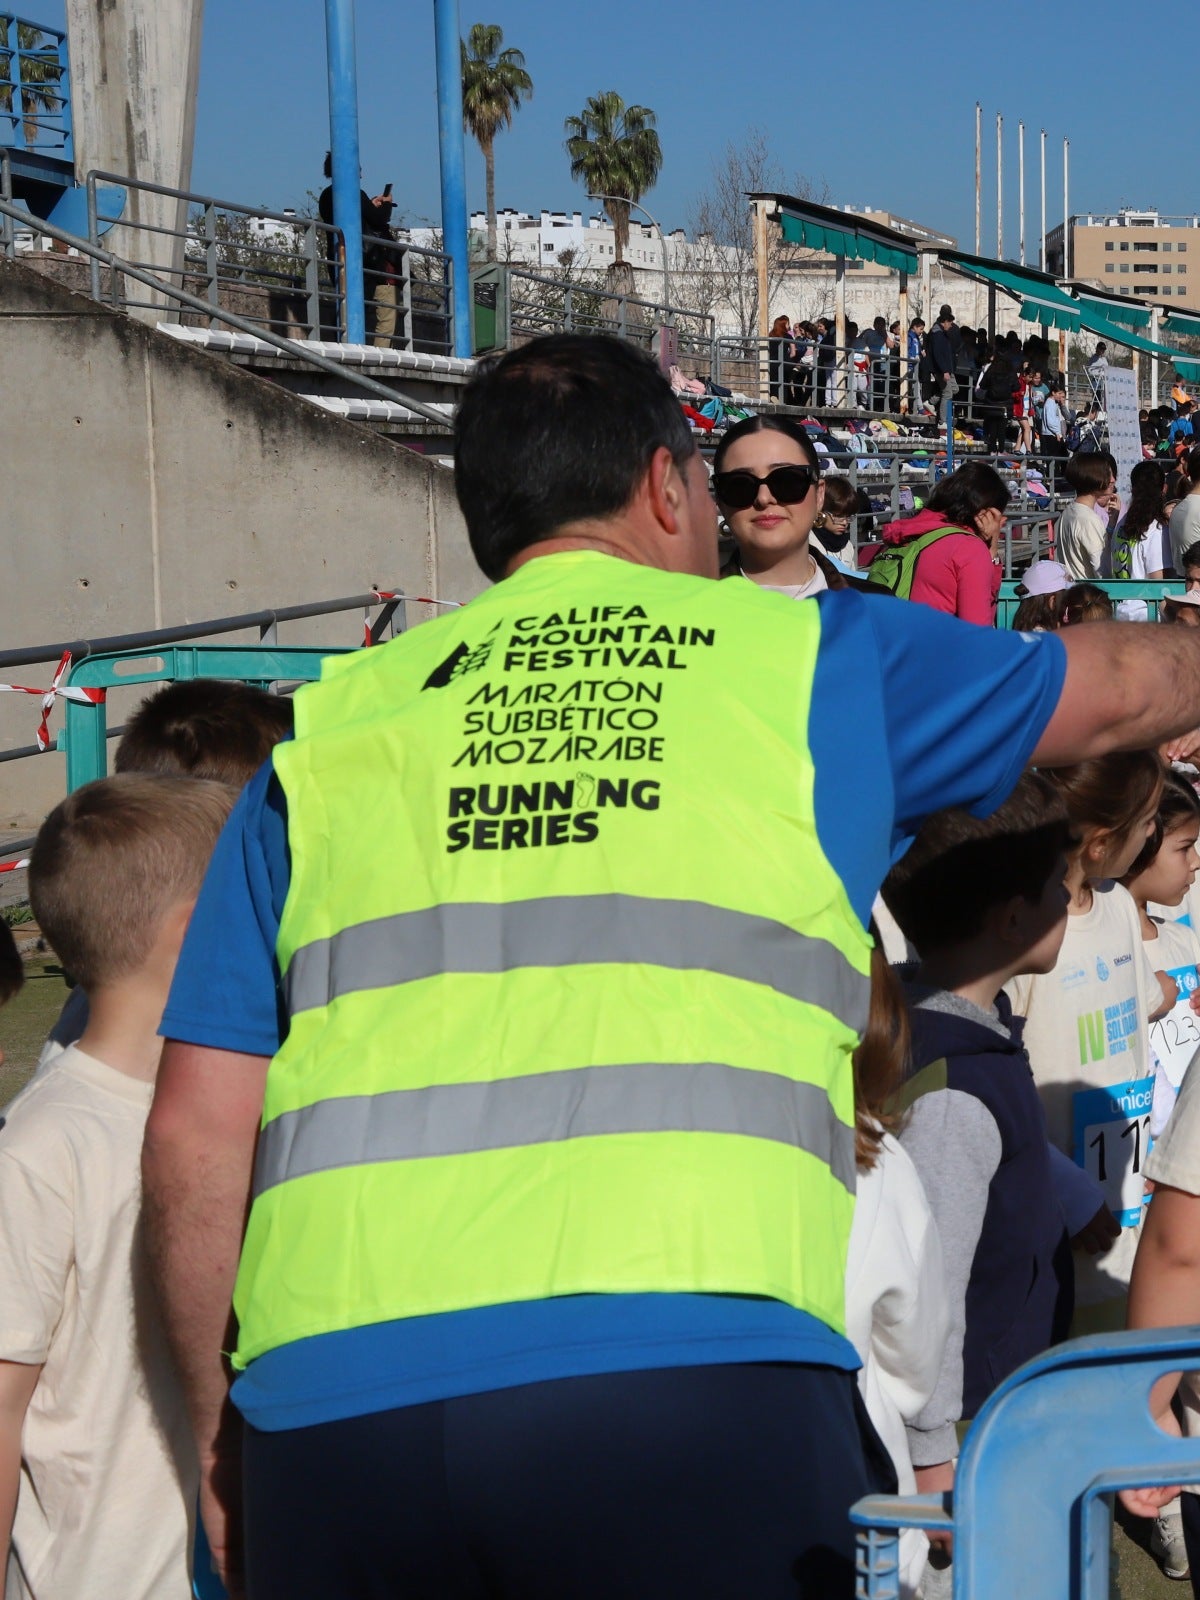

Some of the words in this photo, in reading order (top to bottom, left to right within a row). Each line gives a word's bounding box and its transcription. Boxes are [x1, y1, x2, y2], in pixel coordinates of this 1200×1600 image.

[514, 605, 647, 631] CALIFA
[508, 624, 715, 648] MOUNTAIN
[503, 647, 688, 672] FESTIVAL
[465, 677, 662, 707] MARATÓN
[463, 704, 658, 736] SUBBÉTICO
[450, 732, 665, 767] MOZÁRABE
[447, 812, 599, 853] SERIES
[1078, 1009, 1105, 1065] IV
[1151, 1016, 1200, 1054] 123
